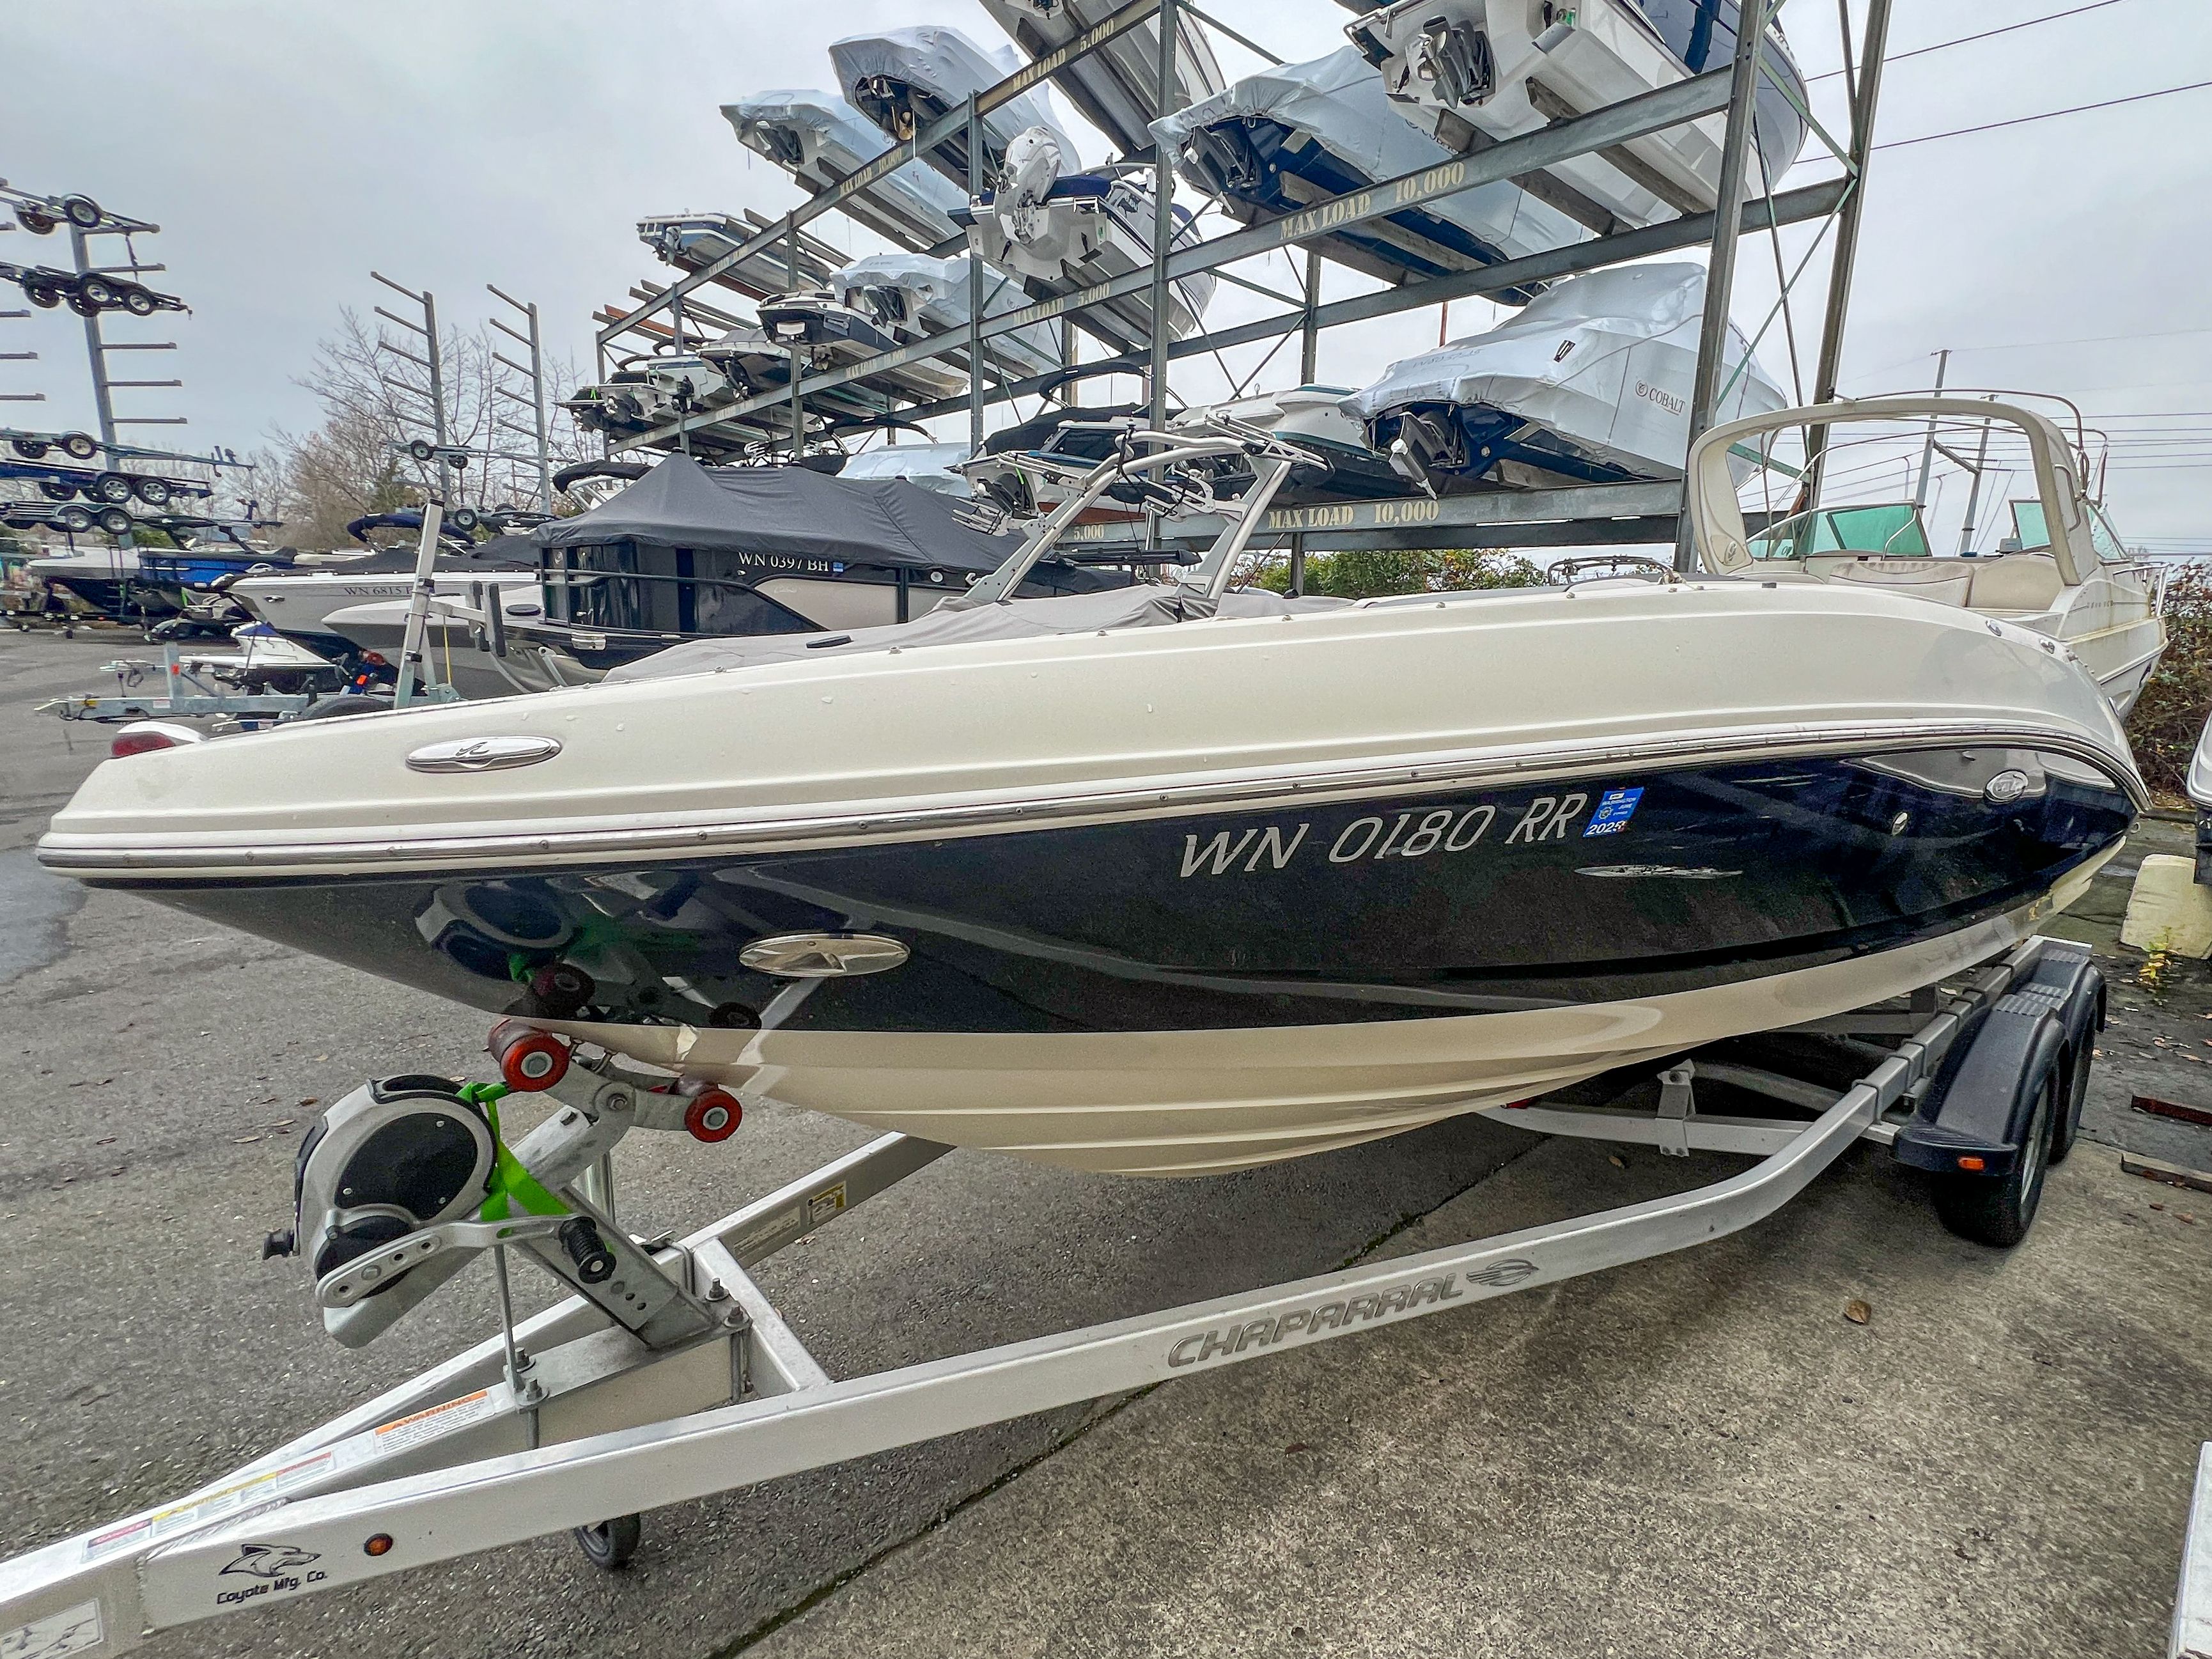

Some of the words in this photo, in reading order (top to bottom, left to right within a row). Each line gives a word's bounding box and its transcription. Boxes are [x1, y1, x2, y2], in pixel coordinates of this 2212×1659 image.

[1013, 65, 1034, 92] MAX
[1037, 48, 1066, 77] LOAD
[1280, 210, 1317, 240] MAX
[1321, 193, 1371, 228] LOAD
[1013, 307, 1034, 324] MAX
[1036, 297, 1064, 318] LOAD
[1649, 387, 1686, 413] COBALT
[1268, 509, 1304, 529] MAX
[1307, 505, 1354, 527] LOAD
[1375, 500, 1438, 526] 10,000
[1073, 524, 1105, 541] 5,000
[738, 552, 765, 566] WN
[1180, 822, 1310, 877] WN
[1328, 805, 1495, 864] 0180
[1505, 793, 1587, 845] RR
[1168, 1273, 1463, 1368] CHAPARRAL
[217, 1584, 269, 1604] Coyote
[306, 1570, 327, 1583] Co.
